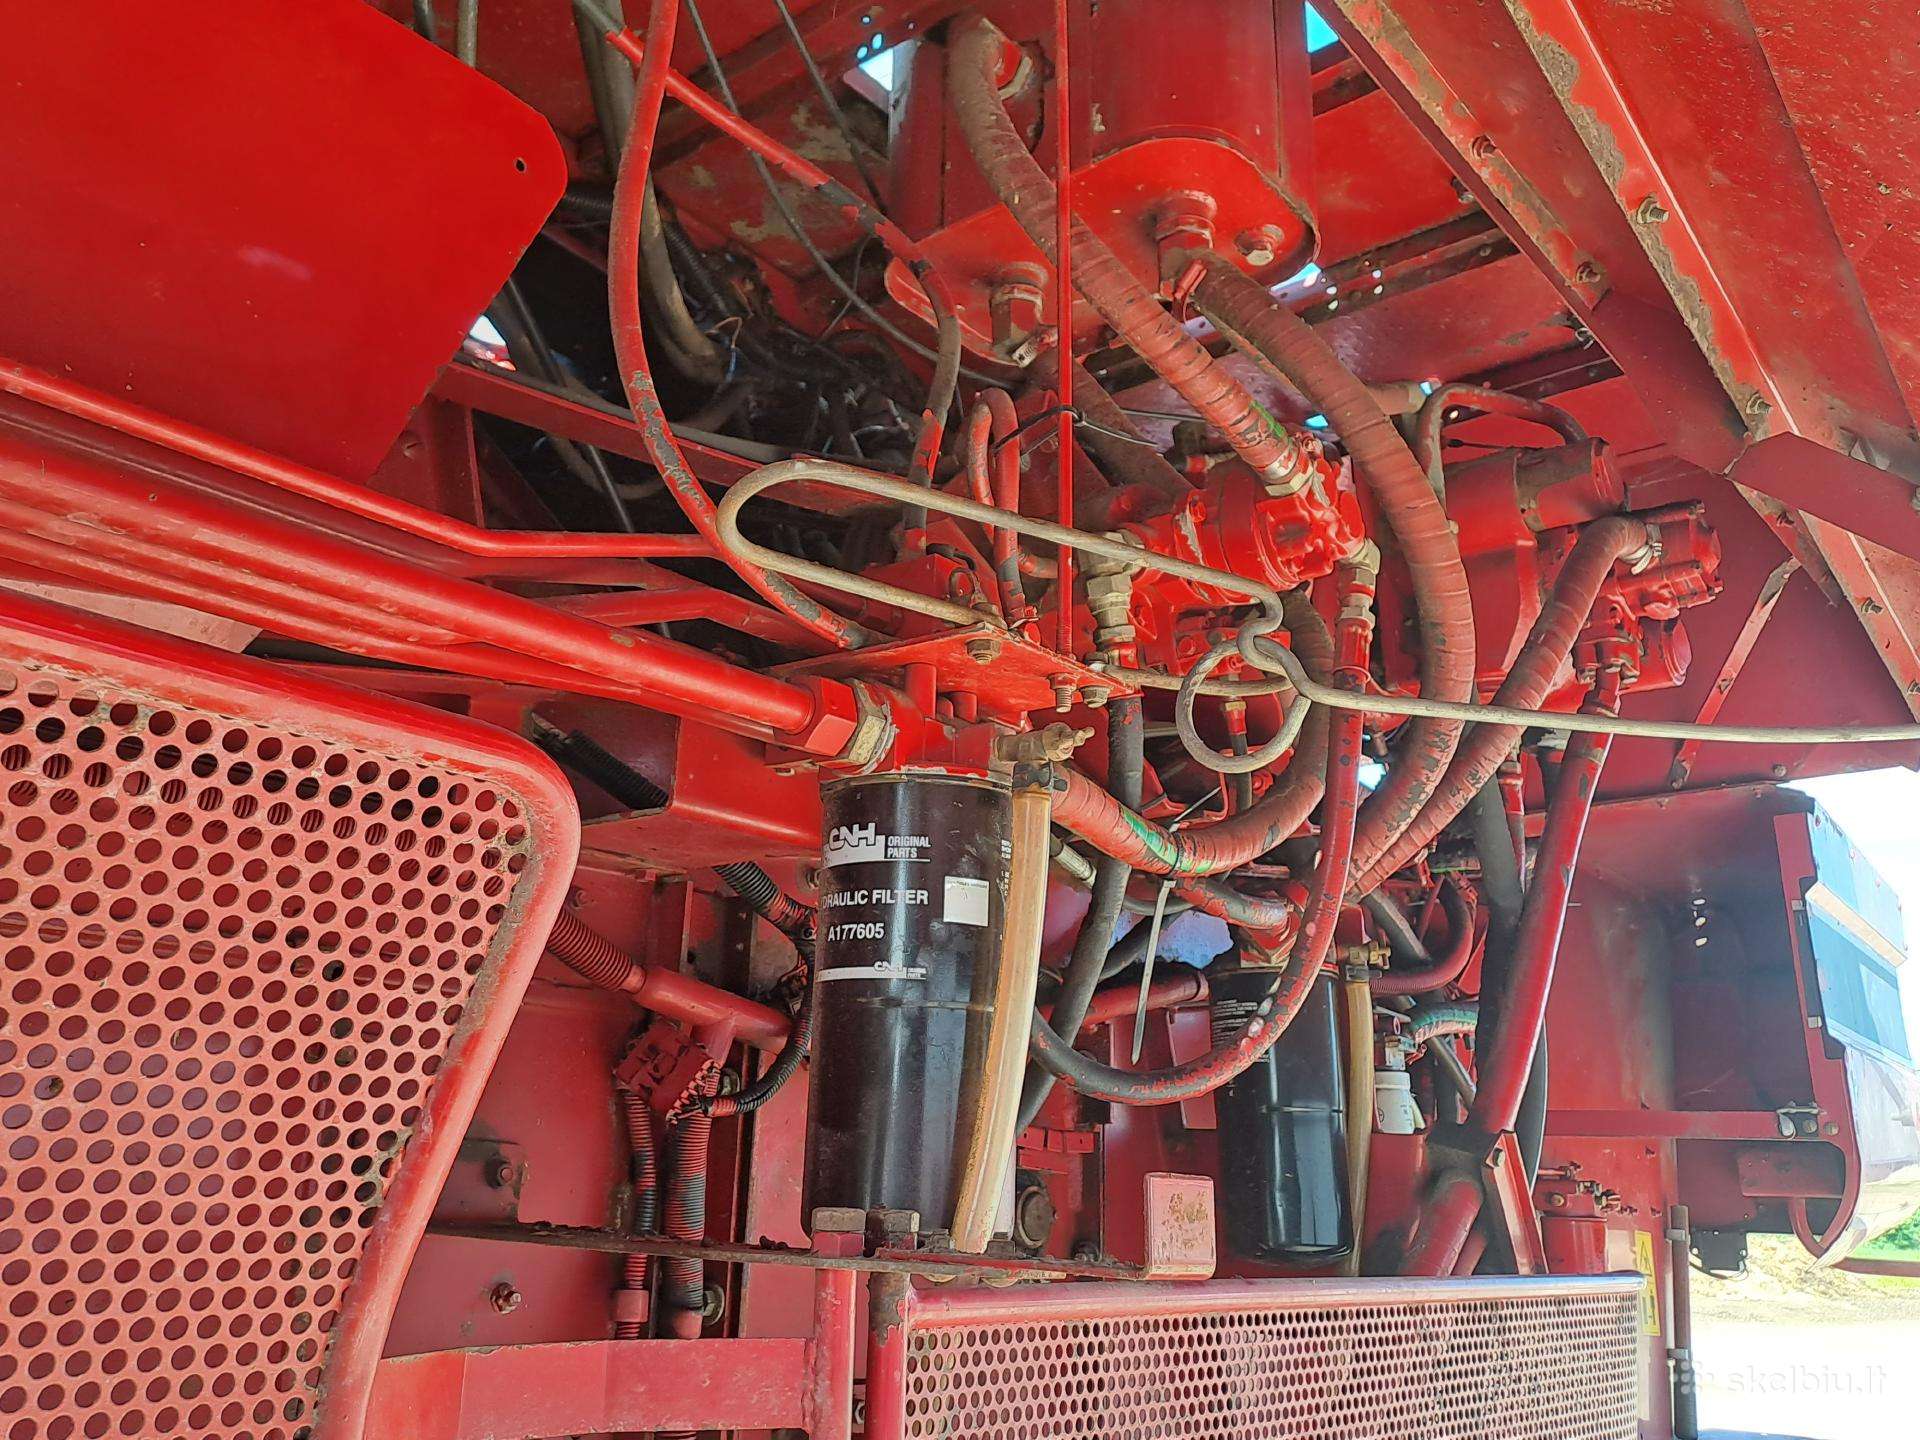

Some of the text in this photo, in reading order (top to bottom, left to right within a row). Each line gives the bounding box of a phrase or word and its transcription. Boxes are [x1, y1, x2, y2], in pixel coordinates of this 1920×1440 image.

[829, 822, 876, 850] CNH
[887, 835, 931, 848] ORIGINAL
[887, 848, 918, 859] PARTS
[872, 889, 929, 905] FILTER
[828, 923, 885, 941] A177605
